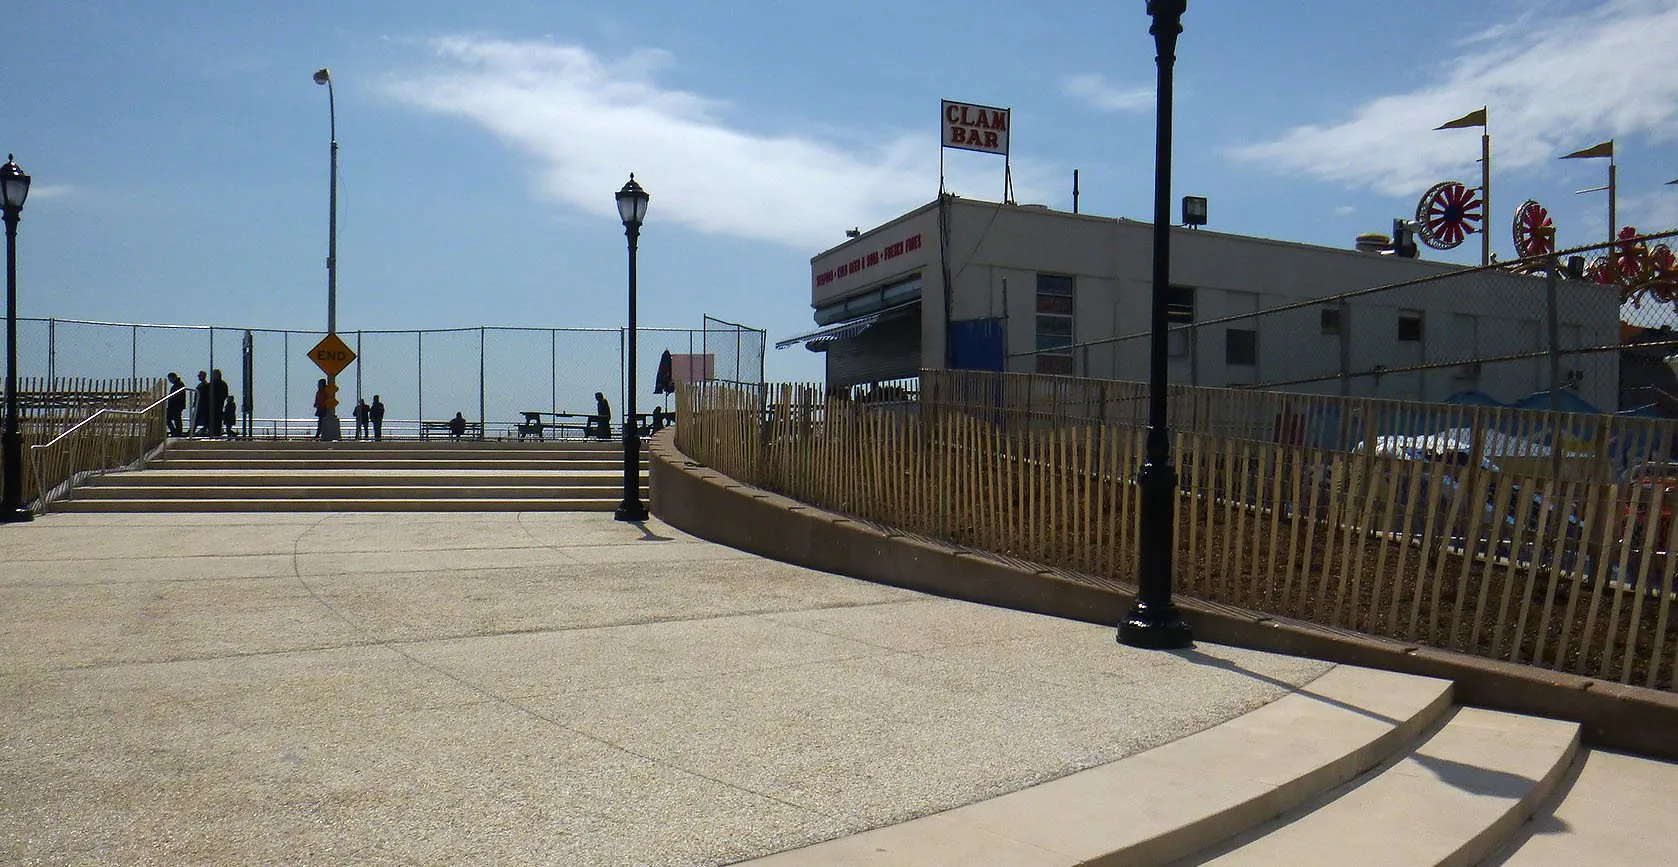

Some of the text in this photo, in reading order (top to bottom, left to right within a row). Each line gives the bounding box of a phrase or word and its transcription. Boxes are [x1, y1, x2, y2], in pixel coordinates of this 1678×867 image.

[945, 105, 1006, 132] CLAM
[950, 126, 999, 148] BAR
[317, 350, 346, 361] END
